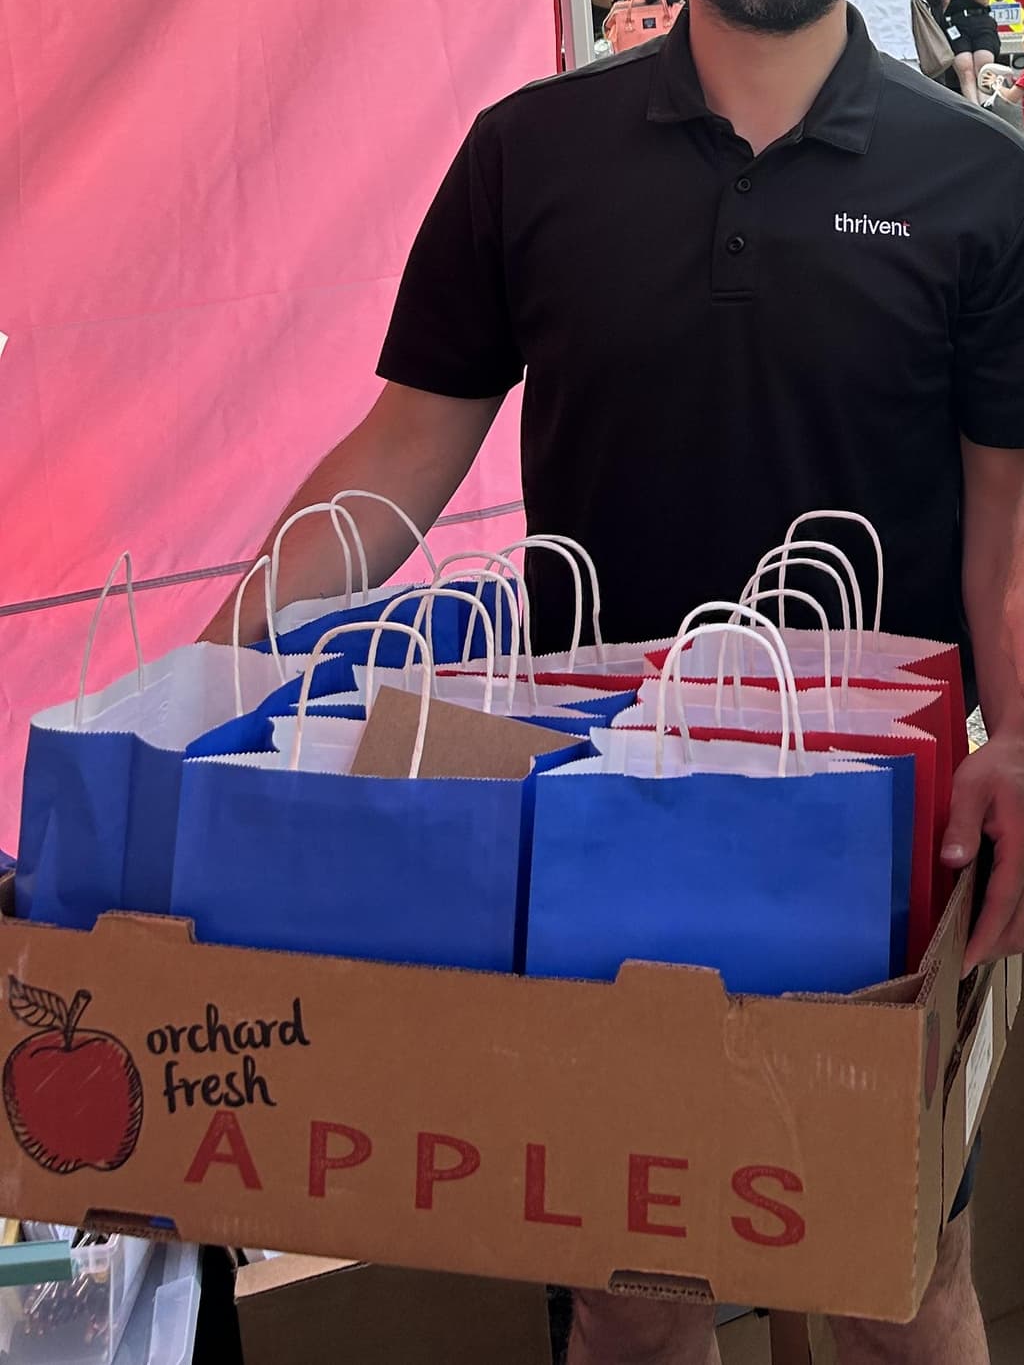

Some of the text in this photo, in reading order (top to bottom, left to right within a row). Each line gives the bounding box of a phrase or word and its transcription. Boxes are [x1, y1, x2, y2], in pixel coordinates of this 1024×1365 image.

[835, 212, 911, 237] thrivent
[147, 997, 311, 1055] orchard
[163, 1055, 277, 1114] fresh
[184, 1110, 806, 1247] APPLES
